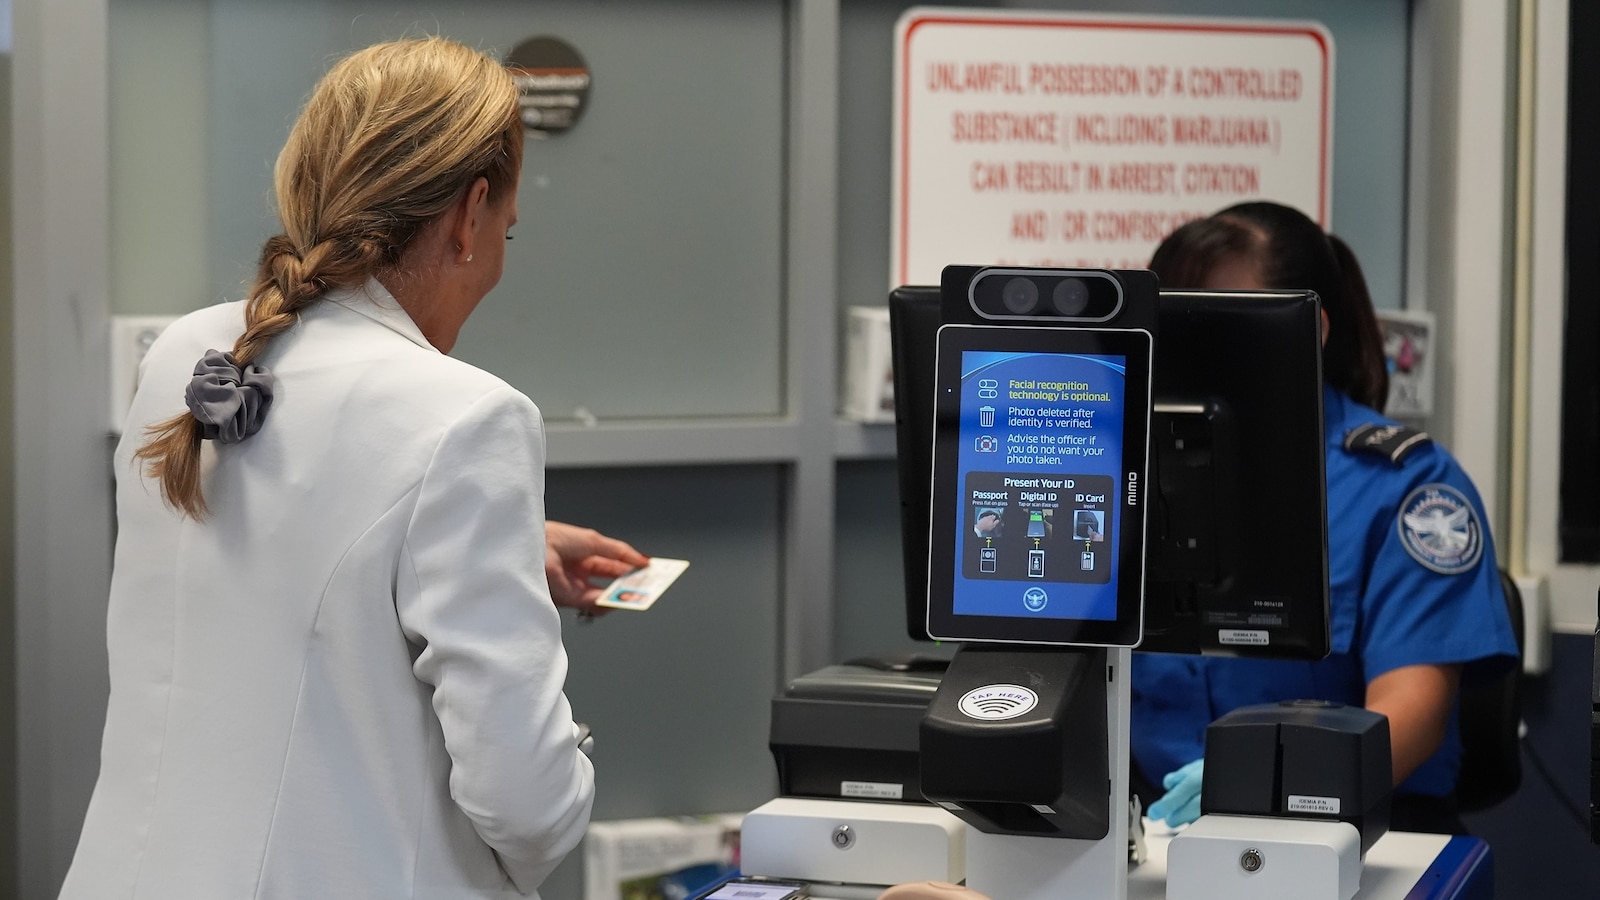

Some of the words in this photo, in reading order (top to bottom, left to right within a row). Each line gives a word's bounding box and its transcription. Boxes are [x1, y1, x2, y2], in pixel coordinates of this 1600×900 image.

[928, 62, 1023, 93] UNLAWFUL
[1030, 63, 1140, 96] POSSESSION
[1147, 65, 1167, 97] OF
[1173, 67, 1185, 95] A
[1189, 67, 1302, 101] CONTROLLED
[952, 111, 1056, 144] SUBSTANCE
[1075, 114, 1168, 145] INCLUDING
[1172, 116, 1271, 147] MARIJUANA
[972, 161, 1009, 192] CAN
[1013, 160, 1080, 193] RESULT
[1086, 163, 1102, 192] IN
[1184, 164, 1259, 195] CITATION
[1011, 210, 1046, 240] AND
[1063, 210, 1087, 242] OR
[1009, 379, 1035, 390] Facial
[1037, 381, 1089, 392] recognition
[1008, 390, 1059, 401] technology
[1061, 391, 1069, 400] is
[1070, 391, 1111, 402] optional.
[1008, 406, 1035, 417] Photo
[1037, 407, 1070, 418] deleted
[1072, 408, 1095, 419] after
[1008, 417, 1043, 429] identity
[1045, 418, 1053, 428] is
[1054, 418, 1093, 429] verified.
[1007, 433, 1039, 444] Advise
[1040, 434, 1056, 445] the
[1057, 434, 1087, 445] officer
[1089, 435, 1096, 446] if
[1007, 445, 1025, 455] you
[1026, 445, 1039, 454] do
[1040, 446, 1056, 455] not
[1057, 446, 1081, 456] want
[1083, 447, 1104, 457] your
[1006, 455, 1034, 465] photo
[1035, 455, 1063, 465] taken.
[1004, 477, 1040, 489] Present
[1040, 478, 1063, 489] Your
[1064, 479, 1075, 489] ID
[1128, 472, 1137, 505] mimo
[972, 490, 1008, 501] Passport
[1020, 491, 1047, 502] Digital
[1047, 492, 1057, 502] ID
[1075, 494, 1085, 503] ID
[1085, 494, 1105, 503] Card
[998, 693, 1029, 701] HERE
